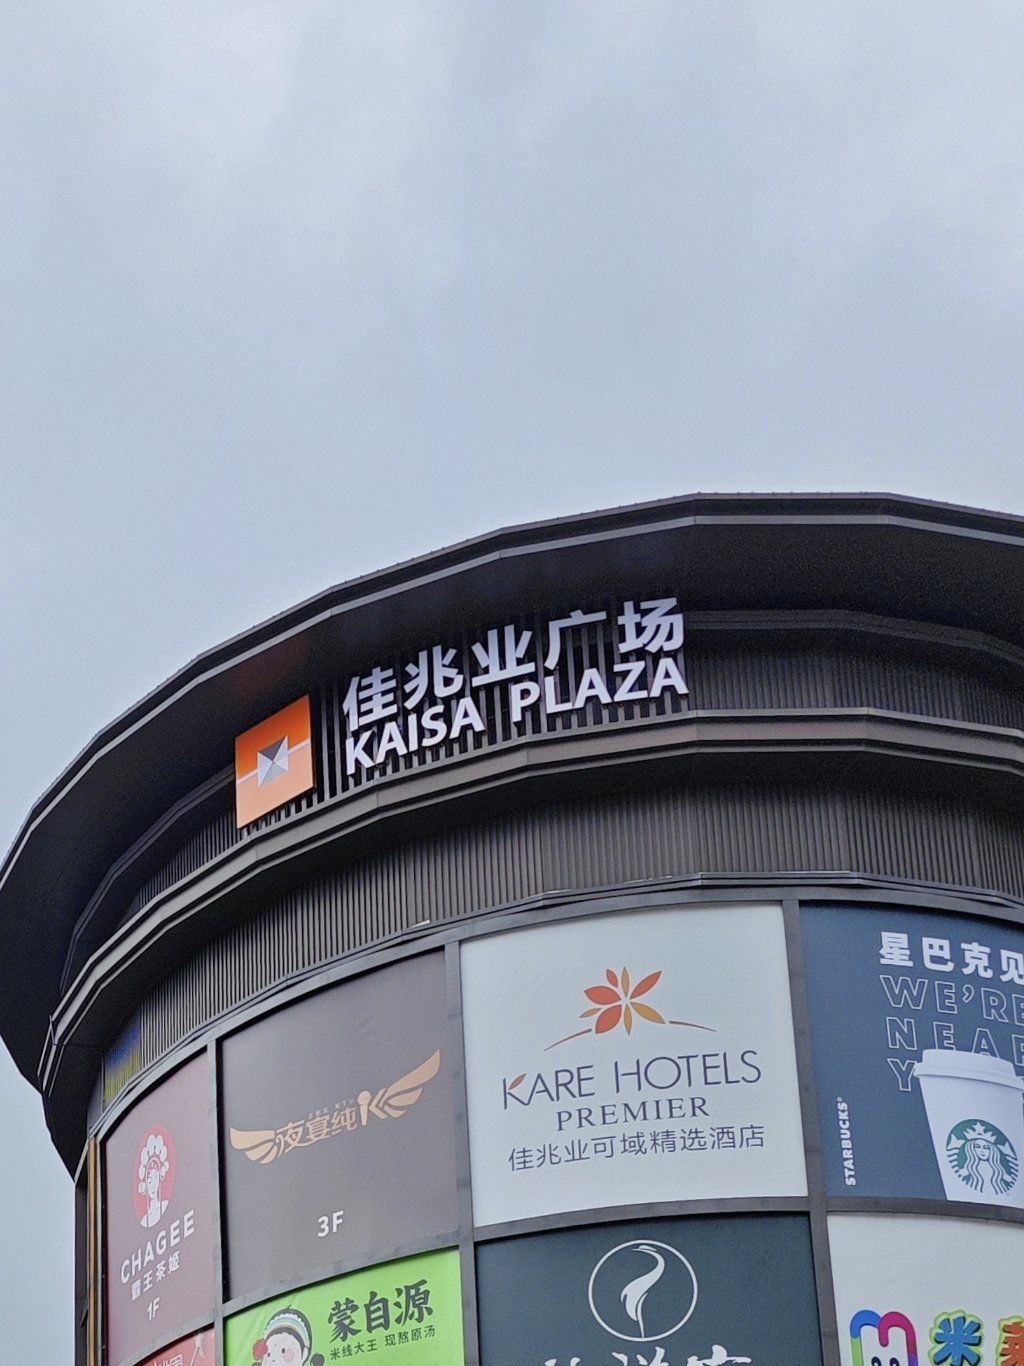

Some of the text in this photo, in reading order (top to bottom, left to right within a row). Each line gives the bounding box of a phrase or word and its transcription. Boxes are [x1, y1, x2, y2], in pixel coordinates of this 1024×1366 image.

[342, 597, 685, 732] 佳兆业广场
[344, 657, 689, 776] KAISA PLAZA
[879, 931, 1024, 985] 星巴克见
[503, 1050, 762, 1110] KARE HOTELS
[556, 1097, 711, 1132] PREMIER
[508, 1124, 766, 1171] 佳兆业可域精选酒店
[120, 1209, 195, 1284] CHAGEE
[316, 1210, 345, 1239] 3F
[131, 1250, 180, 1301] 霸王茶姬
[146, 1296, 161, 1321] 1F
[327, 1278, 435, 1345] 蒙自源
[330, 1324, 436, 1361] 米线大王 现熬原汤
